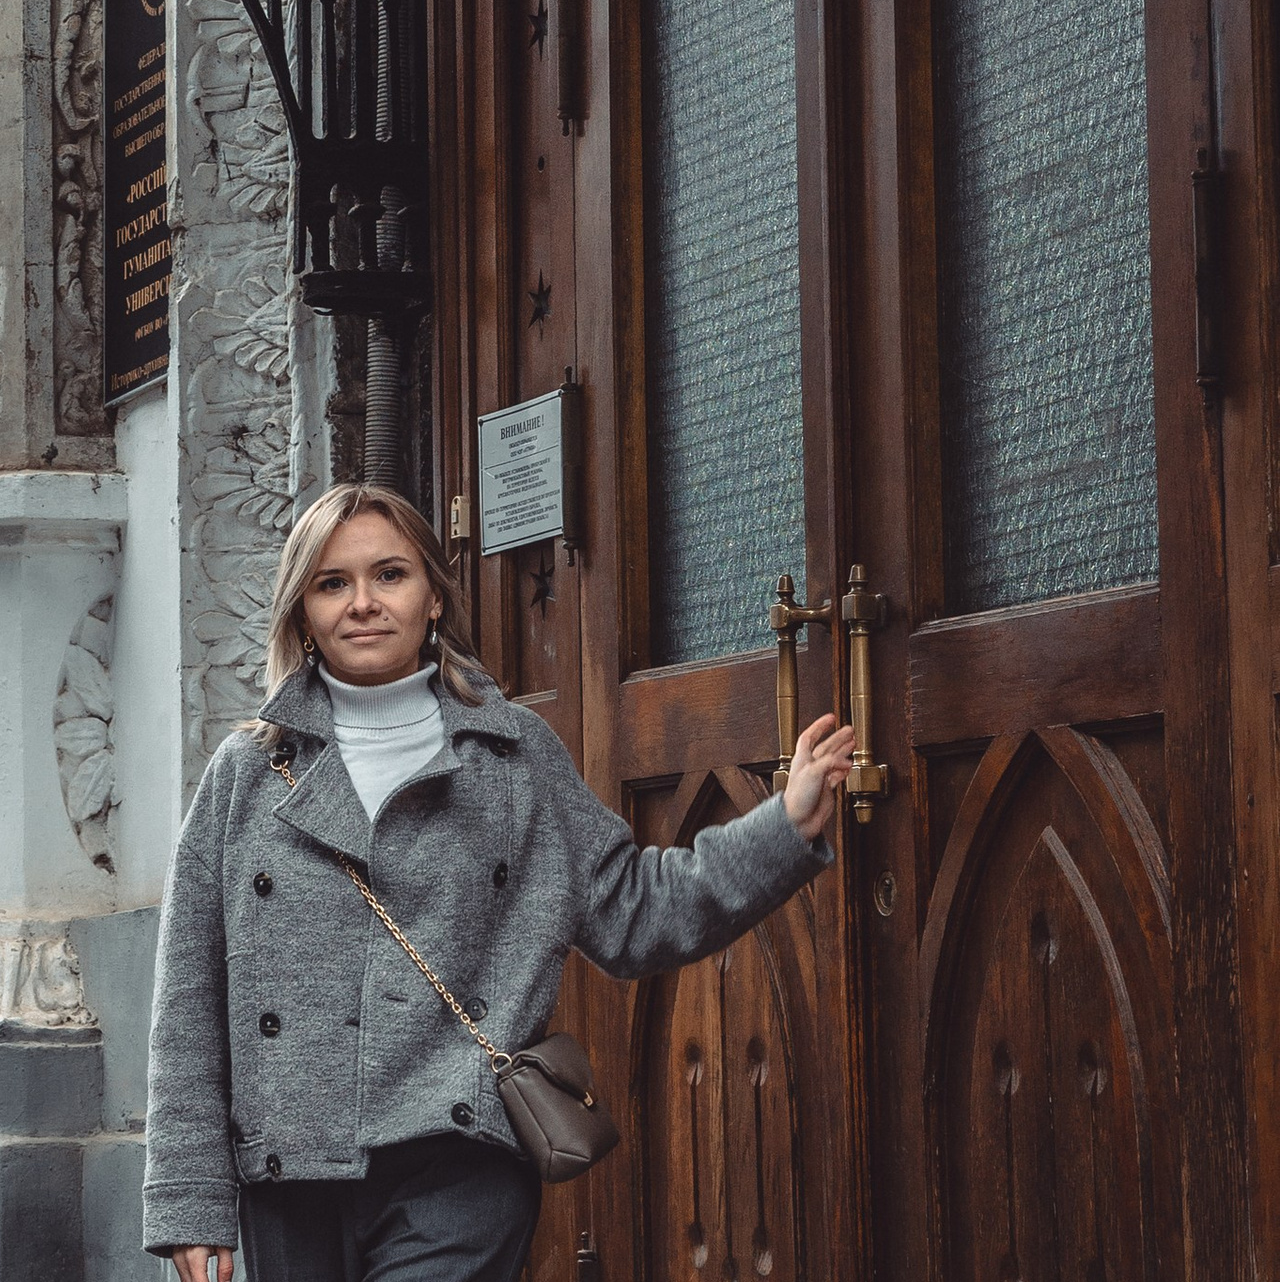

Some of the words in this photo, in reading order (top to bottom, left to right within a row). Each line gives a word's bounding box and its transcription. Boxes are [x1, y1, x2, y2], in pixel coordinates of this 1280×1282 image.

[116, 202, 168, 248] ГОСУДАРСТ
[123, 238, 171, 280] ГУМАНИТА
[500, 415, 545, 440] ВНИМАНИЕ!
